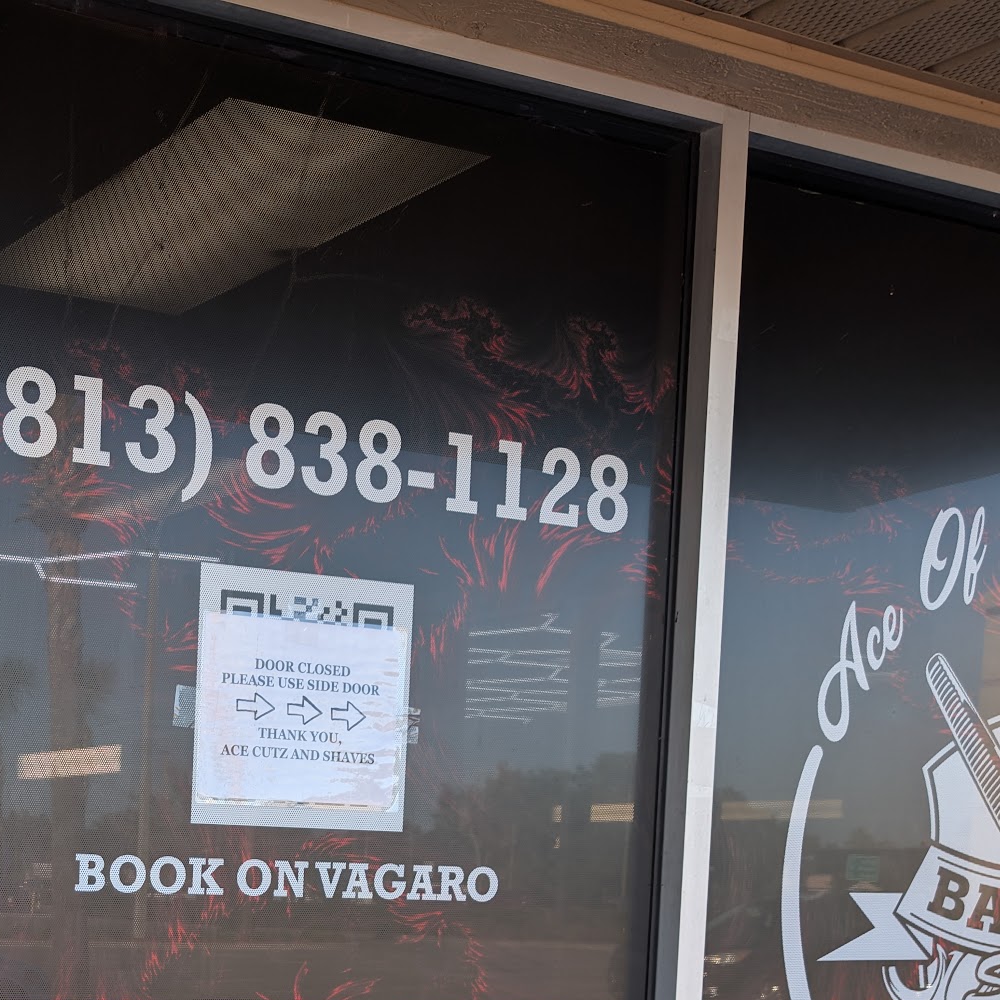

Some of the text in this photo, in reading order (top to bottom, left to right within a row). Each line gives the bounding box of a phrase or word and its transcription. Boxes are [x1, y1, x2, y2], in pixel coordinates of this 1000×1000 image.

[245, 402, 629, 534] 838-1128
[818, 506, 987, 742] Ace Of
[255, 659, 350, 677] DOOR CLOSED
[222, 673, 379, 696] PLEASE USE SIDE DOOR
[258, 728, 342, 745] THANK YOU,
[220, 745, 375, 764] ACE CUTZ AND SHAVES
[75, 854, 499, 902] BOOK ON VAGARO
